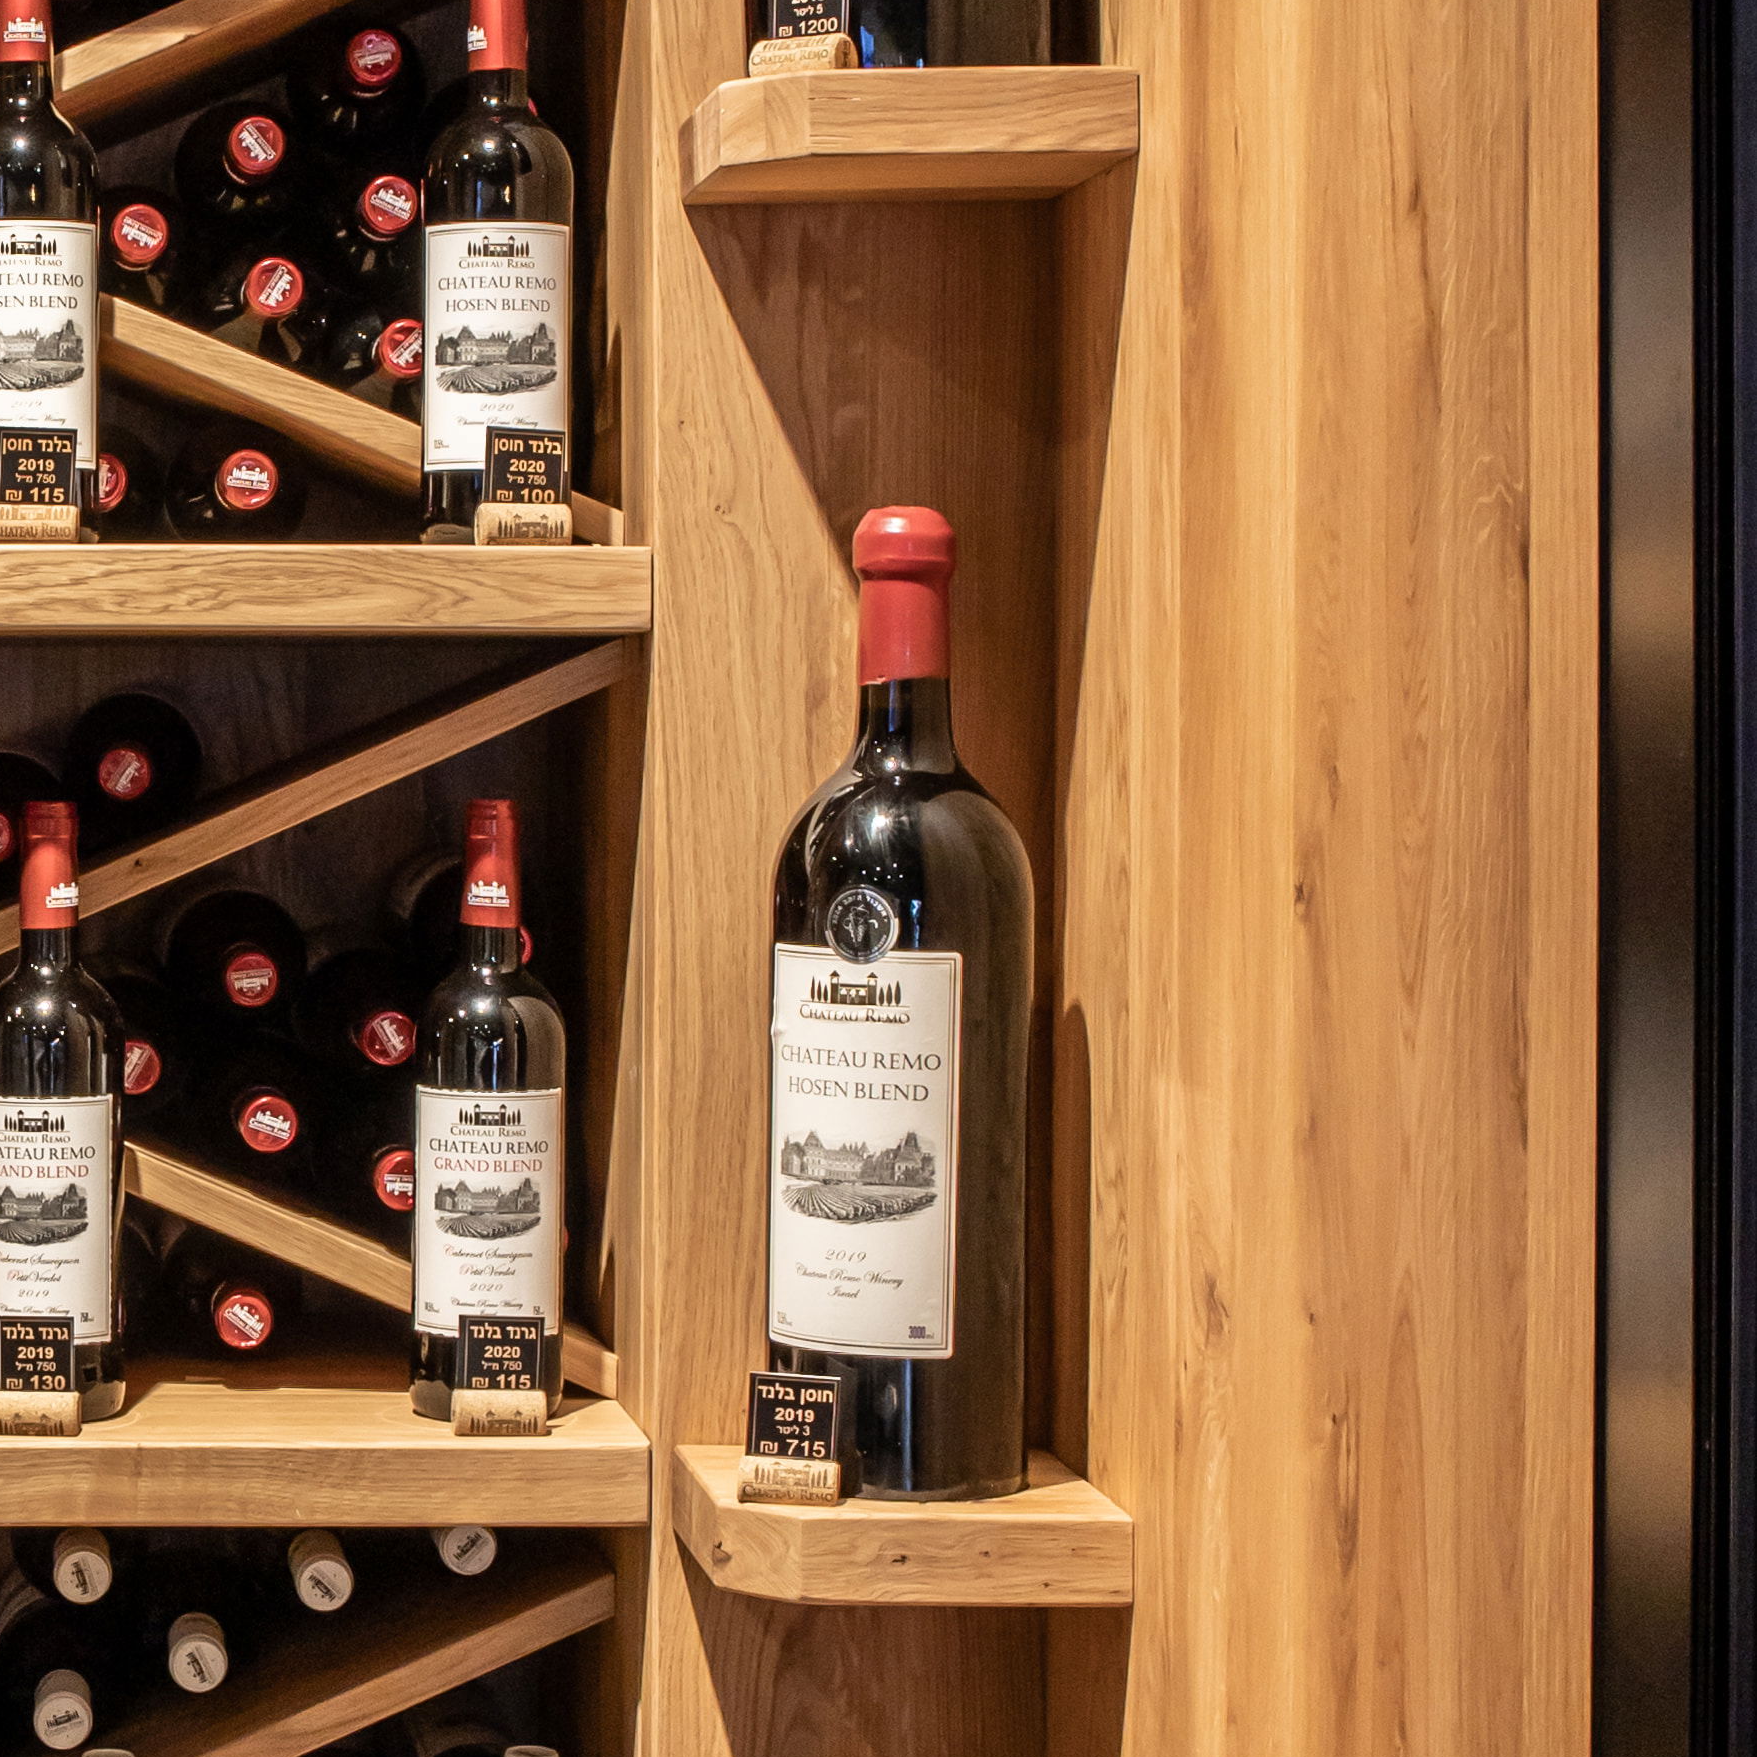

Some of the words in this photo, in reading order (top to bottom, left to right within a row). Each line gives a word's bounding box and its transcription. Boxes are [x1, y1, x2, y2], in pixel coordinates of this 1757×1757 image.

[799, 18, 838, 34] 1200
[42, 274, 84, 288] REMO
[438, 276, 511, 290] CHATEAU
[515, 276, 556, 291] REMO
[29, 295, 78, 309] BLEND
[446, 299, 498, 312] HOSEN
[501, 298, 551, 312] BLEND
[2, 438, 33, 455] חוסן
[37, 436, 72, 453] בלנד
[494, 438, 524, 455] חוסן
[529, 437, 562, 455] בלנד
[18, 458, 55, 472] 2019
[509, 458, 545, 473] 2020
[29, 487, 65, 503] 115
[520, 488, 556, 504] 100
[781, 1044, 867, 1068] CHATEAU
[873, 1052, 942, 1071] REMO
[789, 1076, 849, 1098] HOSEN
[854, 1082, 929, 1101] BLEND
[49, 1146, 96, 1160] REMO
[429, 1138, 502, 1154] CHATEAU
[506, 1140, 548, 1154] REMO
[36, 1164, 89, 1179] BLEND
[434, 1157, 490, 1172] GRAND
[493, 1159, 543, 1172] BLEND
[825, 1249, 867, 1263] 2019
[863, 1269, 904, 1289] Winery
[3, 1323, 35, 1340] בלנד
[38, 1327, 69, 1340] גרנד
[470, 1323, 502, 1339] בלנד
[506, 1327, 536, 1339] גרנד
[17, 1346, 54, 1359] 2019
[484, 1346, 521, 1359] 2020
[29, 1375, 66, 1390] 130
[496, 1374, 531, 1389] 115
[757, 1383, 795, 1400] בלנד
[800, 1388, 833, 1405] חוסן
[774, 1407, 815, 1423] 2019
[786, 1439, 826, 1458] 715
